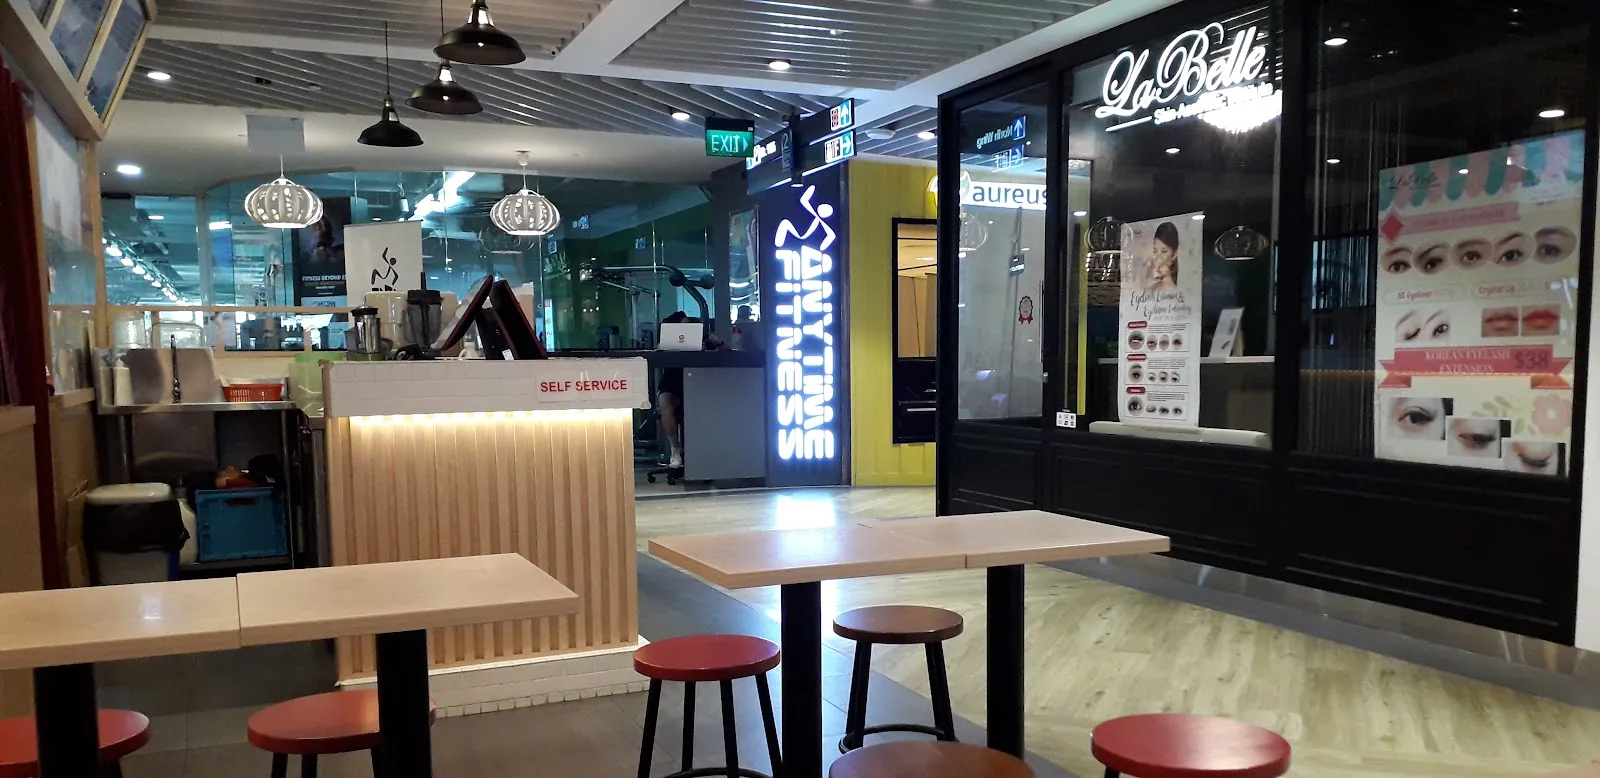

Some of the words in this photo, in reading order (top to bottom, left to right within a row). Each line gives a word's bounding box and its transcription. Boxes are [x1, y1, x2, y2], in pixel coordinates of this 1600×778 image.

[1095, 49, 1161, 118] La
[1157, 22, 1266, 103] Belle
[711, 134, 741, 152] EXIT
[775, 249, 804, 459] FITNESS
[801, 245, 834, 459] ANYTIME
[1425, 350, 1462, 360] KOREAN
[1514, 350, 1549, 370] $38
[540, 381, 572, 392] SELF
[575, 379, 628, 391] SERVICE
